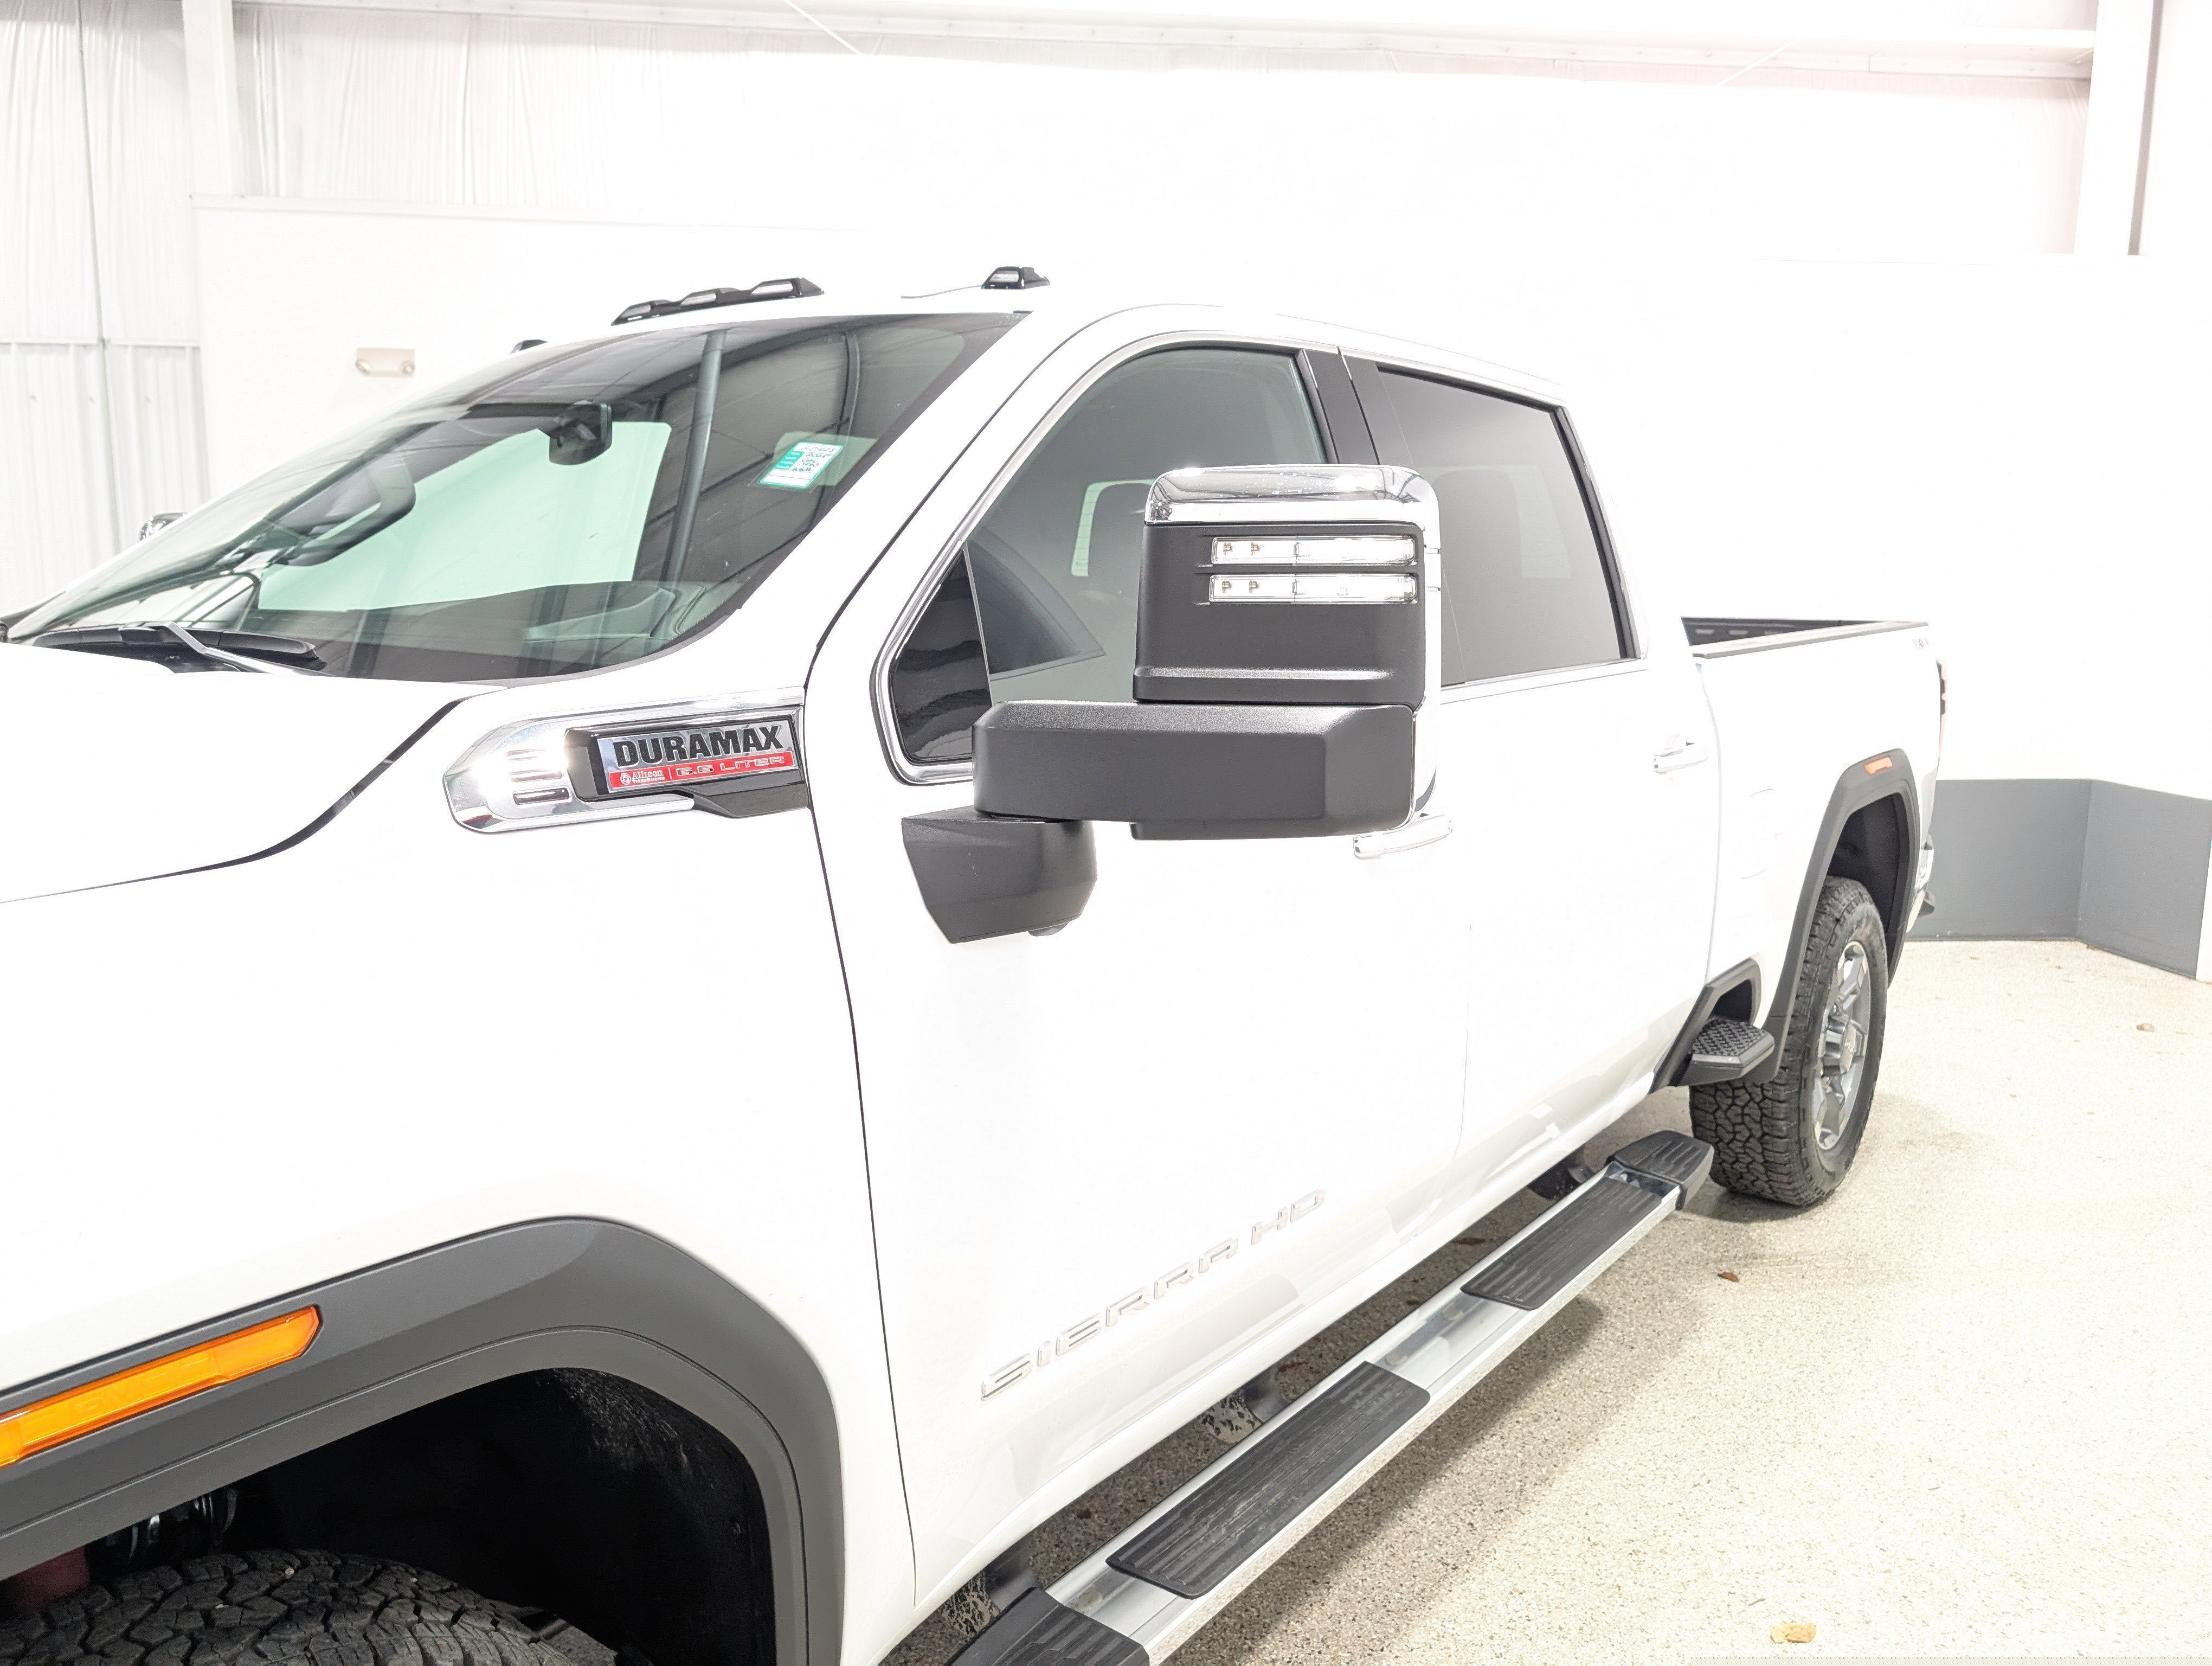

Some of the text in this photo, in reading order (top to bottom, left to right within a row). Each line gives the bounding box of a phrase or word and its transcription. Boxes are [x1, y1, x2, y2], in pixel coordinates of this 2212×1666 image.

[613, 725, 784, 767] DURAMAX
[632, 770, 665, 780] Allison
[677, 755, 786, 777] 6.6 LITER
[981, 1189, 1325, 1401] SIERRA HD
